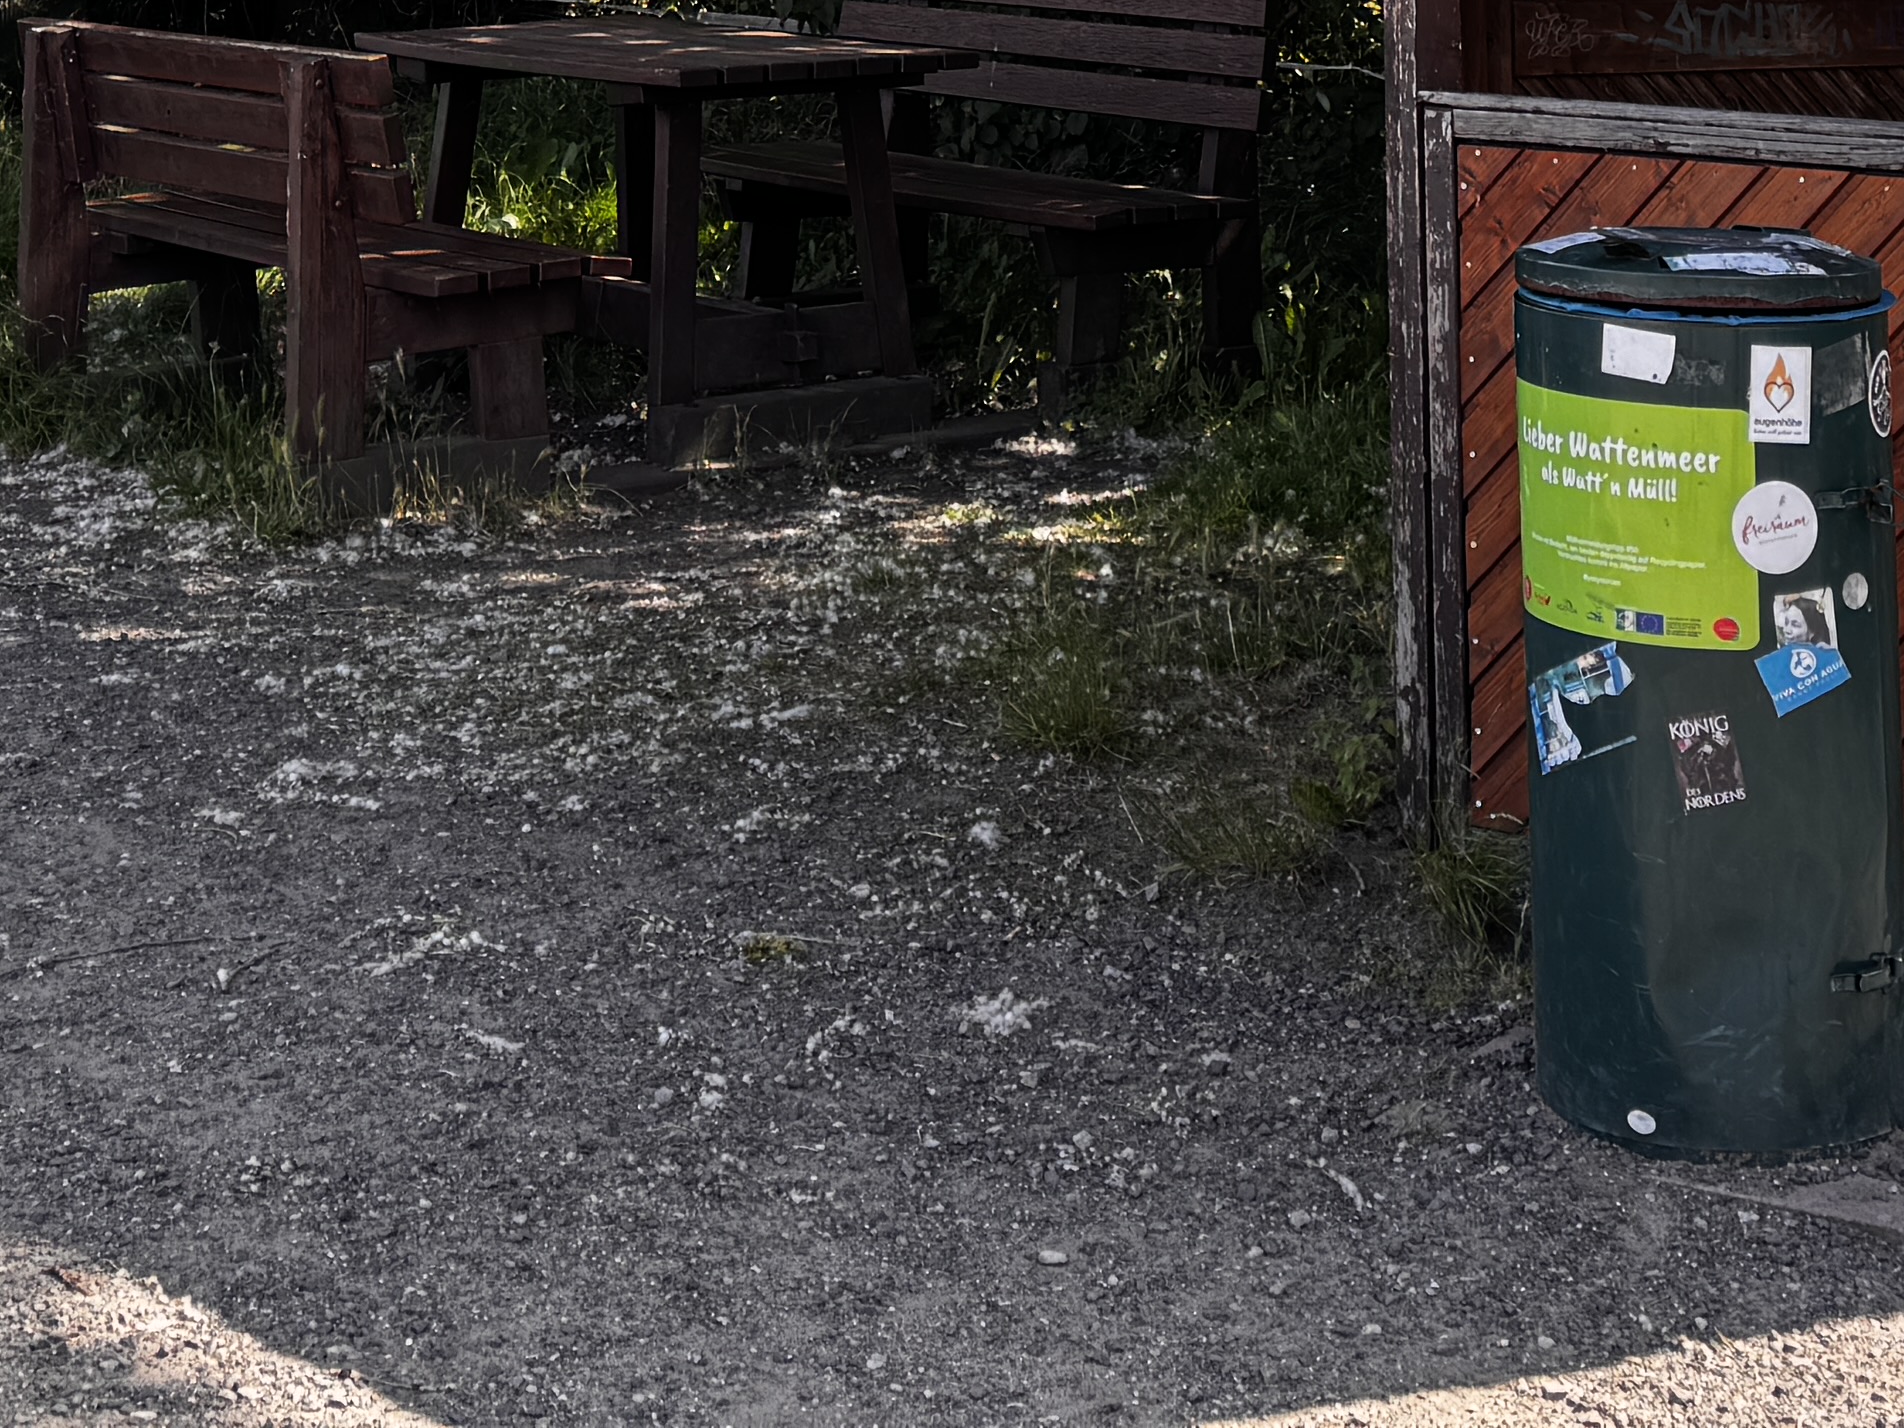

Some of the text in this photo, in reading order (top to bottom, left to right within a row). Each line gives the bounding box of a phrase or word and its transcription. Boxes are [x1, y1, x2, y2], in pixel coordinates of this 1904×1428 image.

[1753, 417, 1803, 429] augenhöhe
[1522, 415, 1721, 474] Lieber Wattenmeer
[1541, 459, 1559, 486] als
[1627, 477, 1678, 503] Müll!
[1797, 673, 1819, 690] CON
[1684, 787, 1747, 811] NORDENS
